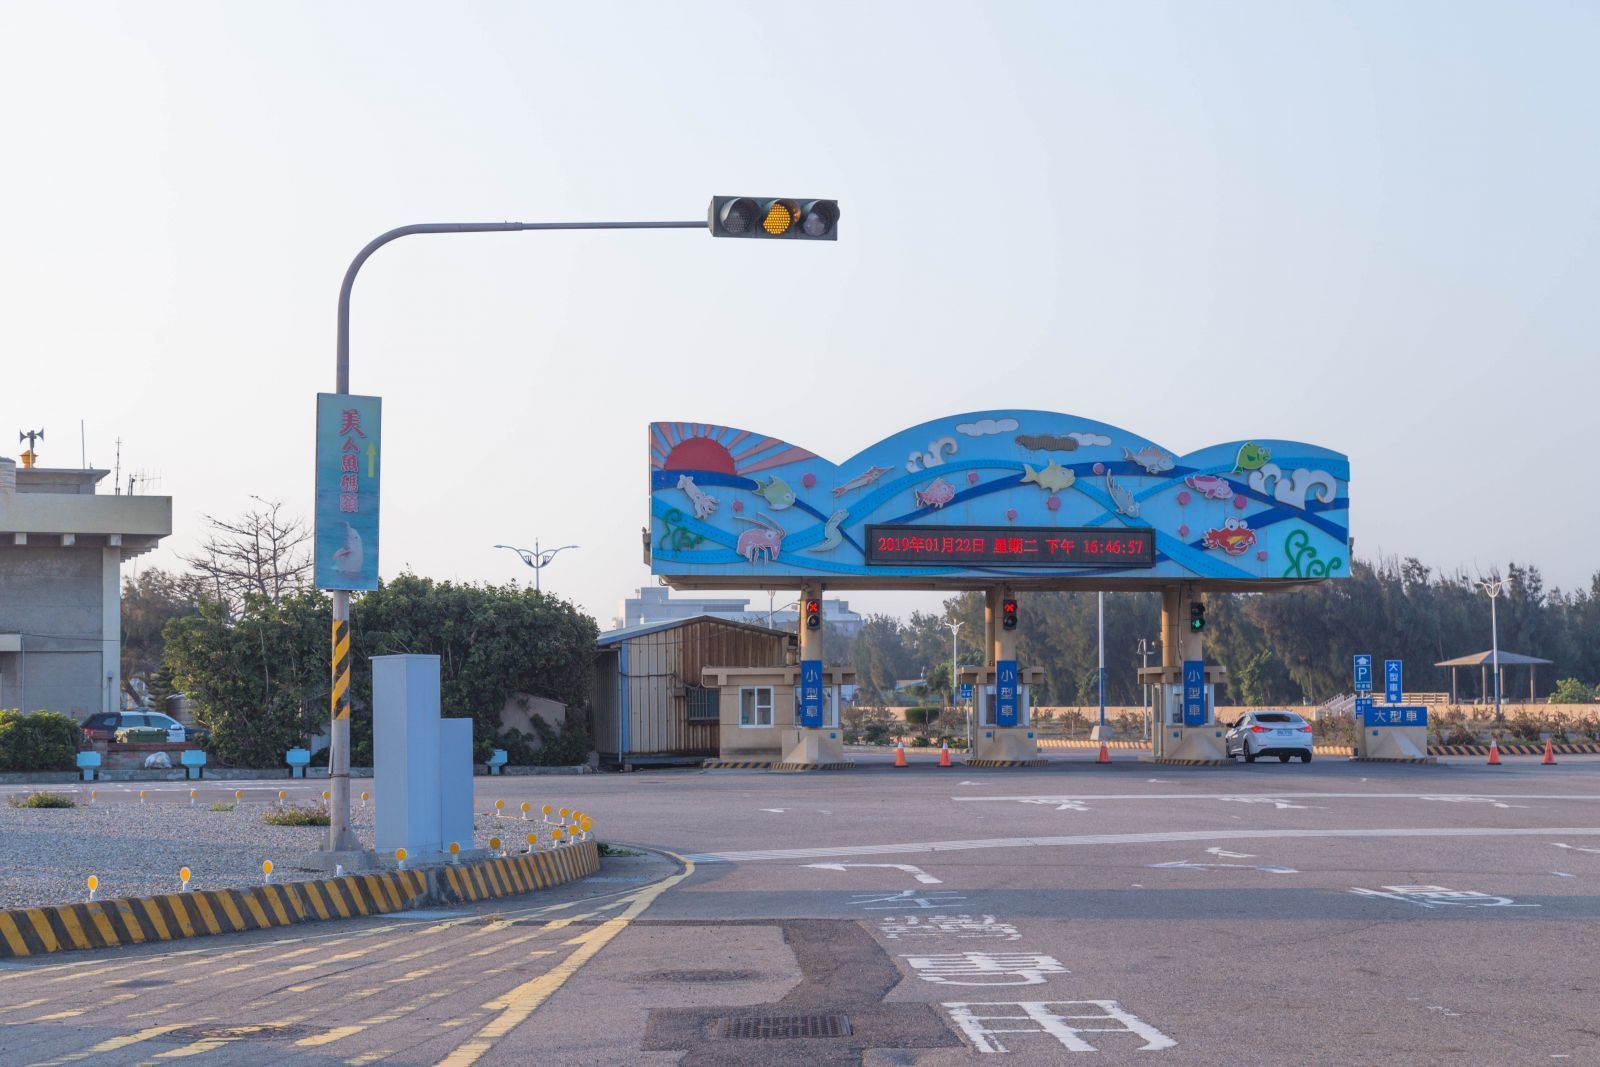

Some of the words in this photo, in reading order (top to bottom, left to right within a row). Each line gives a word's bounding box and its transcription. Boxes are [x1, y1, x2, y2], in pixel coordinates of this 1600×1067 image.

[878, 536, 985, 553] 2019年01月22日
[993, 538, 1039, 555] 星期二
[1045, 538, 1075, 555] 下午
[1083, 539, 1144, 555] 16:46:57
[1358, 668, 1367, 681] P
[805, 669, 819, 718] 小型車
[1000, 669, 1014, 718] 小型車
[1188, 669, 1203, 718] 小型車
[1374, 710, 1418, 723] 大型車
